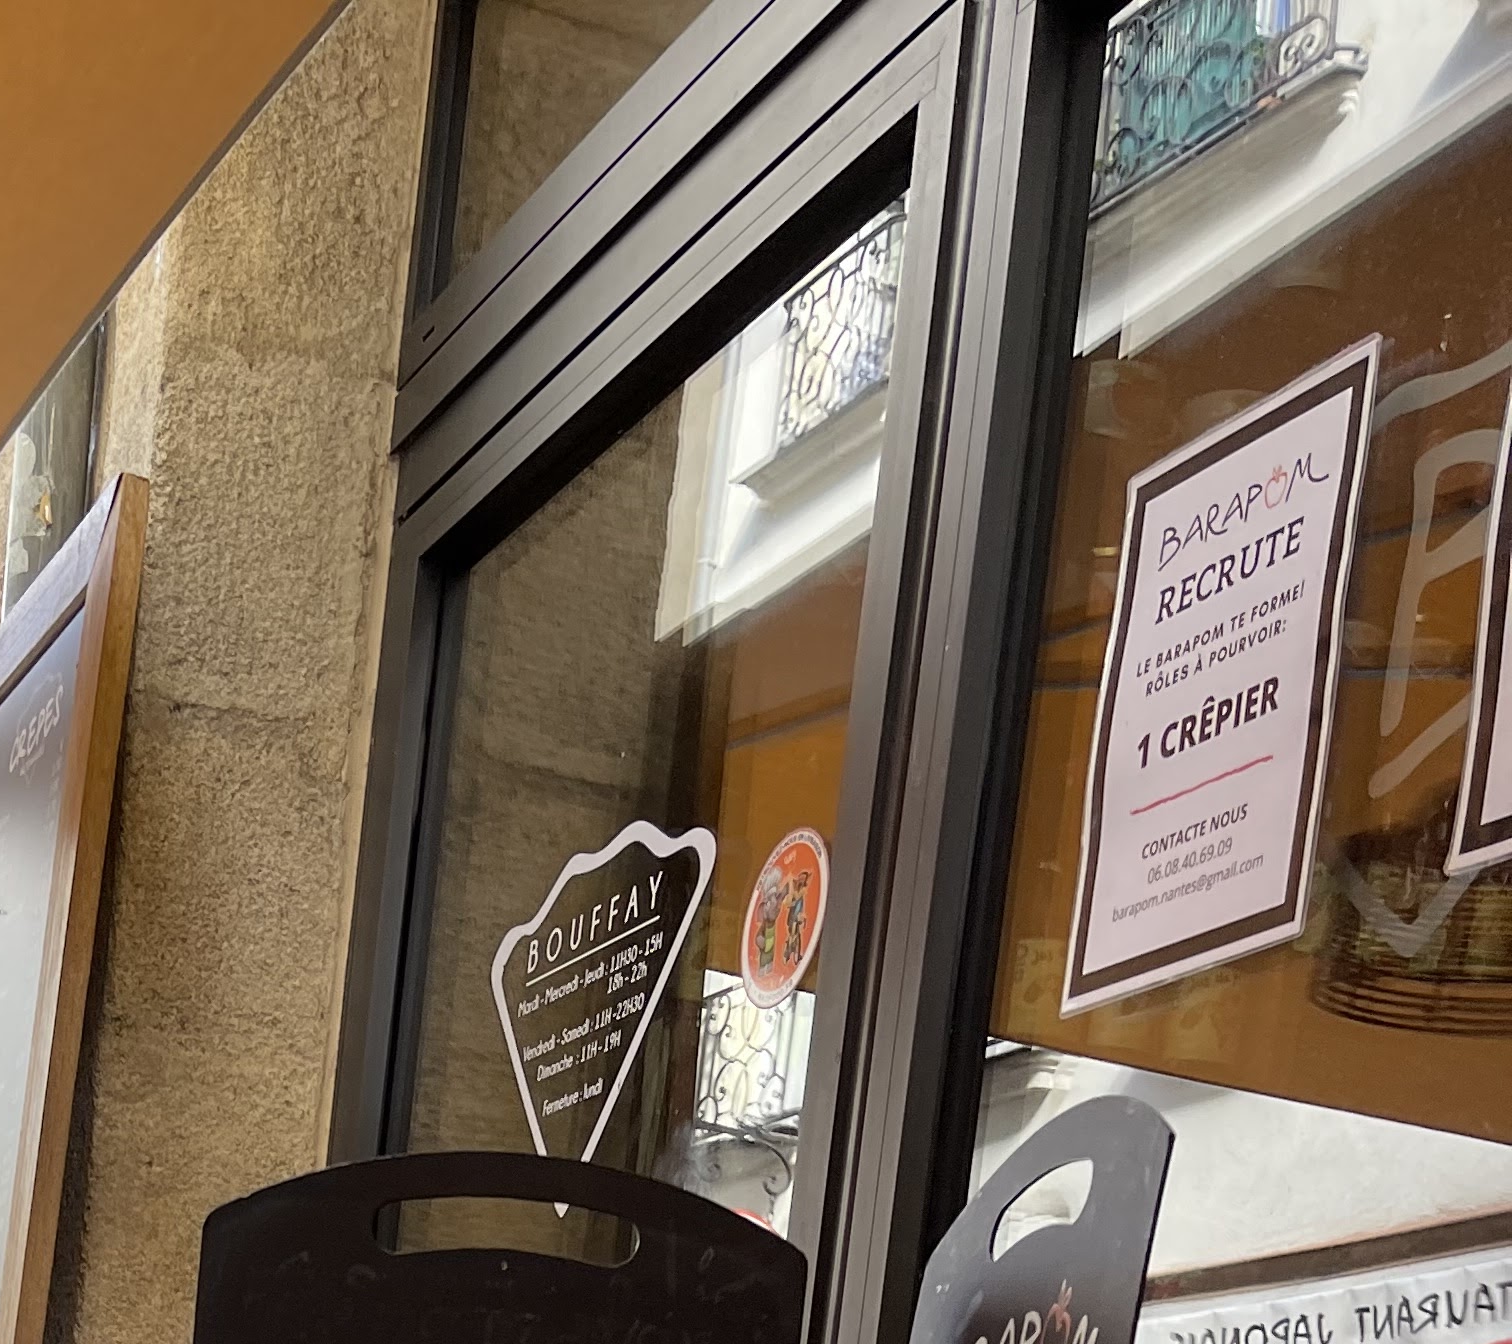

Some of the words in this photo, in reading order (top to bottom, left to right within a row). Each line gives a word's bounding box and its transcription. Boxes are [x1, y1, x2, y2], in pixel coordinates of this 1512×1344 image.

[1155, 516, 1305, 625] RECRUTE
[1135, 658, 1151, 678] LE
[1155, 622, 1224, 668] BARAPOM
[1230, 612, 1246, 631] TE
[1251, 580, 1306, 622] FORME!
[1145, 663, 1189, 698] RÔLES
[1193, 652, 1203, 676] À
[1208, 619, 1287, 668] POURVOIR:
[1137, 733, 1151, 769] 1
[1160, 676, 1280, 760] CRÊPIER
[1141, 818, 1208, 860] CONTACTE
[1209, 803, 1248, 836] NOUS
[1147, 837, 1233, 884] 06.08.40.69.09
[526, 871, 664, 974] BOUFFAY
[1112, 854, 1264, 922] barapom.nantes@gmail.com
[517, 993, 540, 1018] Mardi
[544, 975, 579, 1005] Mercredi
[609, 945, 638, 974] 11H30
[644, 931, 664, 957] 15H
